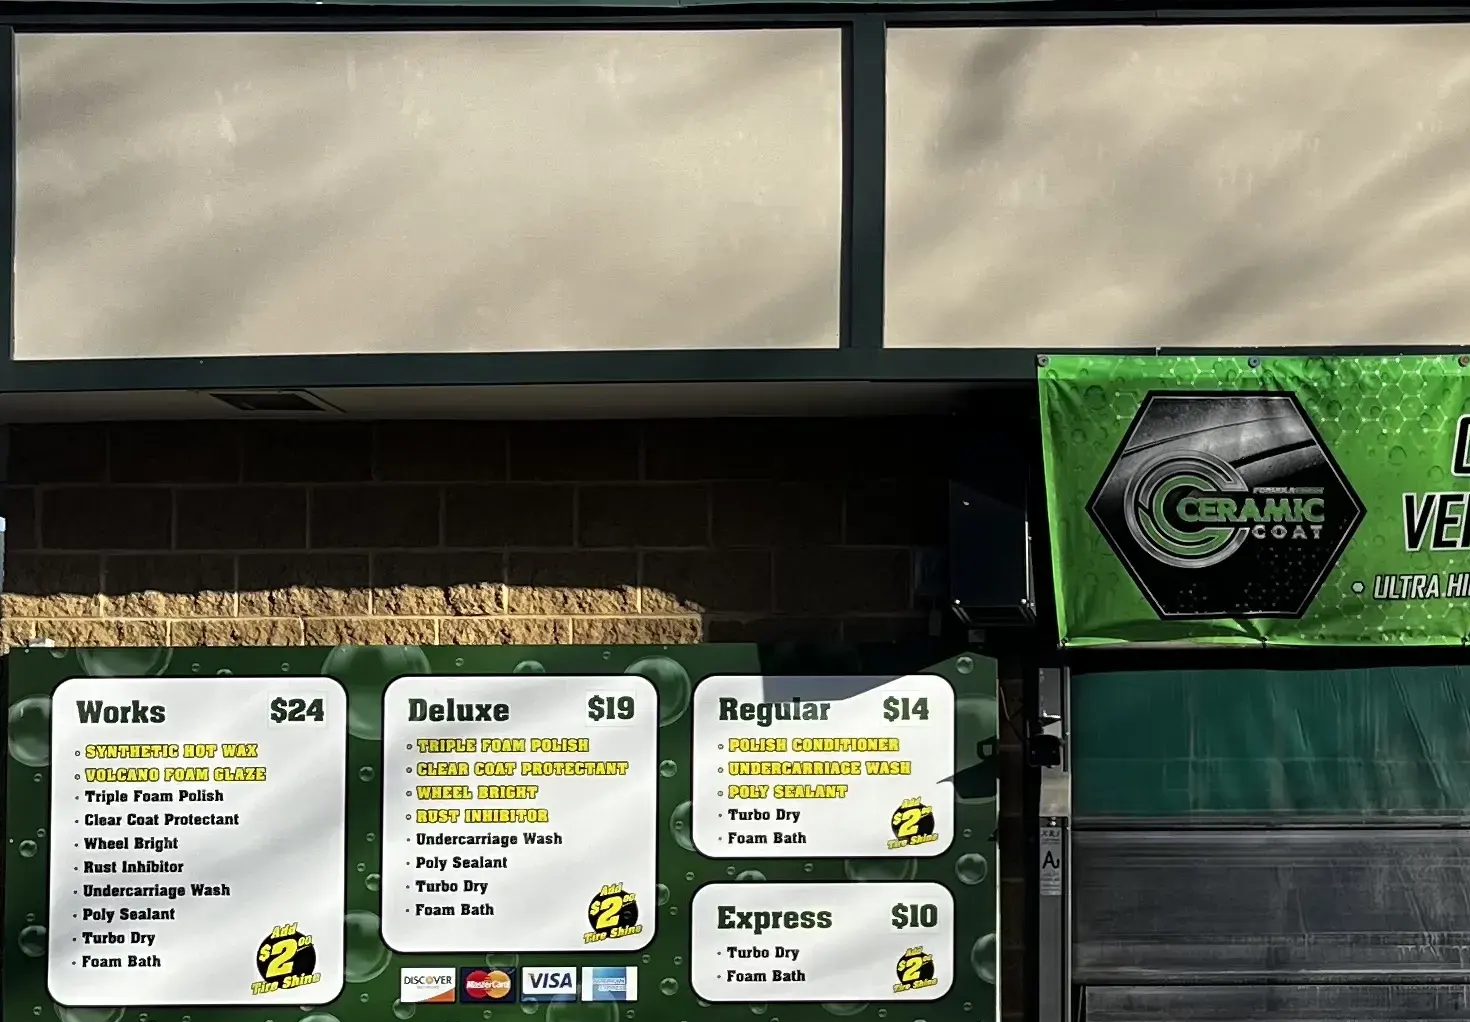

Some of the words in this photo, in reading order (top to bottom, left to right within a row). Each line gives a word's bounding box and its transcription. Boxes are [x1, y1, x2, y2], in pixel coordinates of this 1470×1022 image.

[1177, 497, 1325, 522] CERAMIC
[1252, 525, 1323, 539] COAT
[1374, 575, 1441, 600] ULTRA
[77, 700, 165, 723] Works
[270, 697, 324, 723] $24
[408, 698, 509, 722] Deluxe
[588, 695, 635, 721] $19
[719, 698, 830, 726] Regular
[883, 697, 929, 722] $14
[85, 744, 179, 758] SYNTHETIC
[183, 744, 217, 758] HOT
[222, 744, 258, 758] WAX
[417, 739, 476, 753] TRIPLE
[481, 739, 525, 752] FOAM
[531, 738, 589, 752] POLISH
[729, 738, 787, 752] POLISH
[792, 738, 899, 751] CONDITIONER
[85, 768, 160, 782] VOLCANO
[164, 768, 208, 781] FOAM
[214, 768, 266, 781] GLAZE
[417, 762, 469, 776] CLEAR
[474, 762, 516, 775] COAT
[521, 762, 628, 775] PROTECTANT
[728, 762, 861, 775] UNDERCARRIAGE
[866, 762, 911, 775] WASH
[85, 791, 128, 804] Triple
[134, 791, 173, 802] Foam
[179, 790, 223, 802] Polish
[417, 786, 472, 799] WHEEL
[478, 786, 538, 799] BRIGHT
[728, 786, 769, 799] POLY
[774, 785, 848, 798] SEALANT
[85, 814, 122, 826] Clear
[127, 814, 159, 826] Coat
[164, 813, 239, 825] Protectant
[416, 810, 459, 822] RUST
[465, 809, 548, 822] INHIBITOR
[728, 809, 770, 821] Turbo
[776, 809, 800, 823] Dry
[84, 838, 128, 849] Wheel
[134, 838, 178, 852] Bright
[416, 833, 517, 847] Undercarriage
[523, 833, 562, 845] Wash
[728, 833, 767, 844] Foam
[773, 832, 807, 844] Bath
[84, 861, 116, 873] Rust
[122, 861, 183, 873] Inhibitor
[416, 857, 447, 871] Poly
[453, 857, 507, 868] Sealant
[83, 885, 185, 899] Undercarriage
[191, 884, 230, 896] Wash
[416, 880, 458, 892] Turbo
[464, 881, 488, 895] Dry
[83, 909, 114, 923] Poly
[120, 908, 175, 920] Sealant
[415, 904, 455, 916] Foam
[461, 904, 494, 915] Bath
[717, 906, 832, 934] Express
[892, 903, 938, 928] $10
[82, 932, 125, 944] Turbo
[131, 932, 155, 947] Dry
[82, 956, 121, 967] Foam
[128, 955, 161, 967] Bath
[727, 947, 769, 959] Turbo
[775, 947, 799, 961] Dry
[404, 976, 452, 984] DISCOVER
[528, 973, 572, 988] VISA
[727, 971, 766, 982] Foam
[772, 971, 806, 982] Bath
[466, 980, 511, 989] MasterCard
